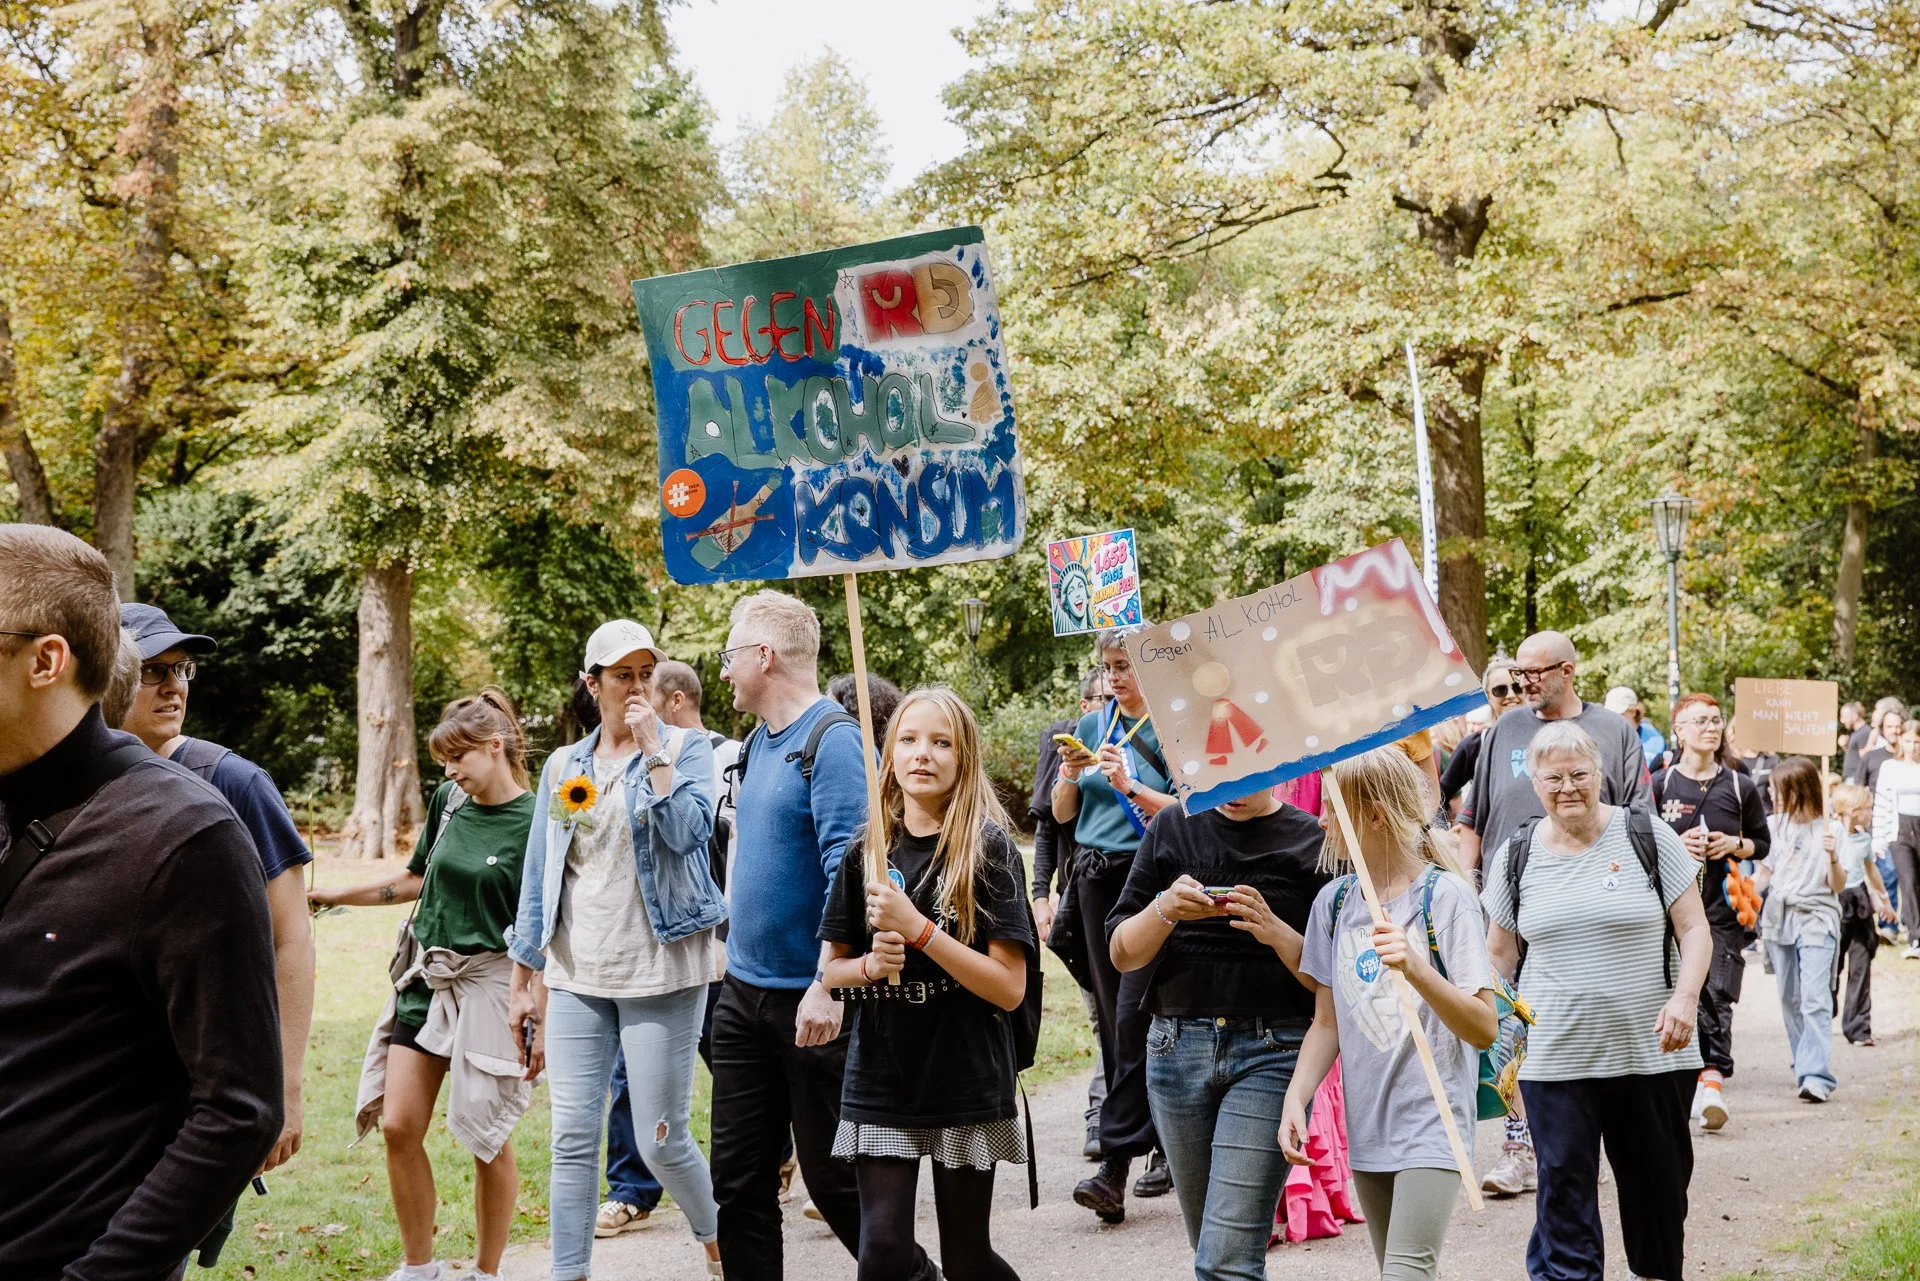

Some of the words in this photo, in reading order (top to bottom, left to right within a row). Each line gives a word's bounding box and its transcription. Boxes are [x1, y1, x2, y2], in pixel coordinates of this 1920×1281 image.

[674, 291, 837, 366] GEGEN
[686, 373, 976, 470] ALKOHOL
[794, 461, 1015, 567] KONSUM
[1093, 542, 1128, 574] 1.658
[1100, 565, 1124, 587] TAGE
[1139, 638, 1193, 663] Gegen
[1752, 709, 1779, 720] MAN
[1360, 956, 1380, 969] VOLL
